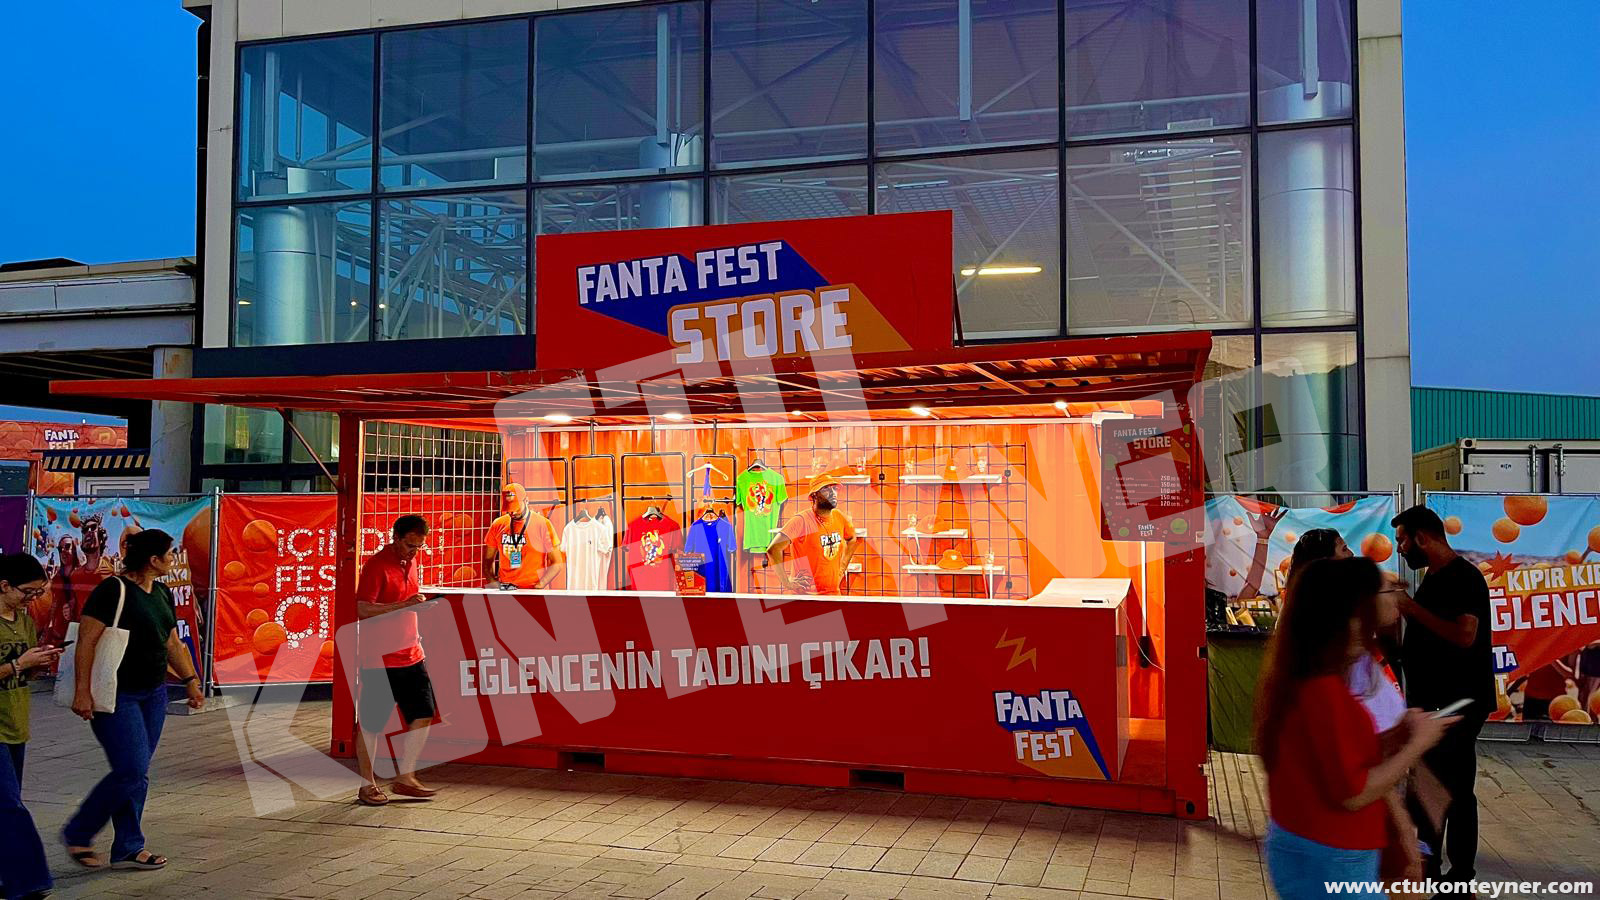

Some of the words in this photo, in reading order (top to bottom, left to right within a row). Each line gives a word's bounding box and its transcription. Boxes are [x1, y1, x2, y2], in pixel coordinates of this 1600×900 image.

[577, 255, 687, 305] FANTA
[696, 241, 783, 290] FEST
[671, 288, 853, 364] STORE
[44, 429, 79, 441] FANTA
[1113, 428, 1137, 438] FANTA
[1138, 427, 1157, 436] FEST
[1133, 436, 1171, 449] STORE
[1507, 567, 1567, 592] KIPIR
[459, 640, 662, 696] EĞLENCENİN
[671, 643, 790, 688] TADINI
[800, 637, 932, 689] ÇIKAR!
[994, 691, 1084, 724] FANTA
[1014, 729, 1075, 761] FEST
